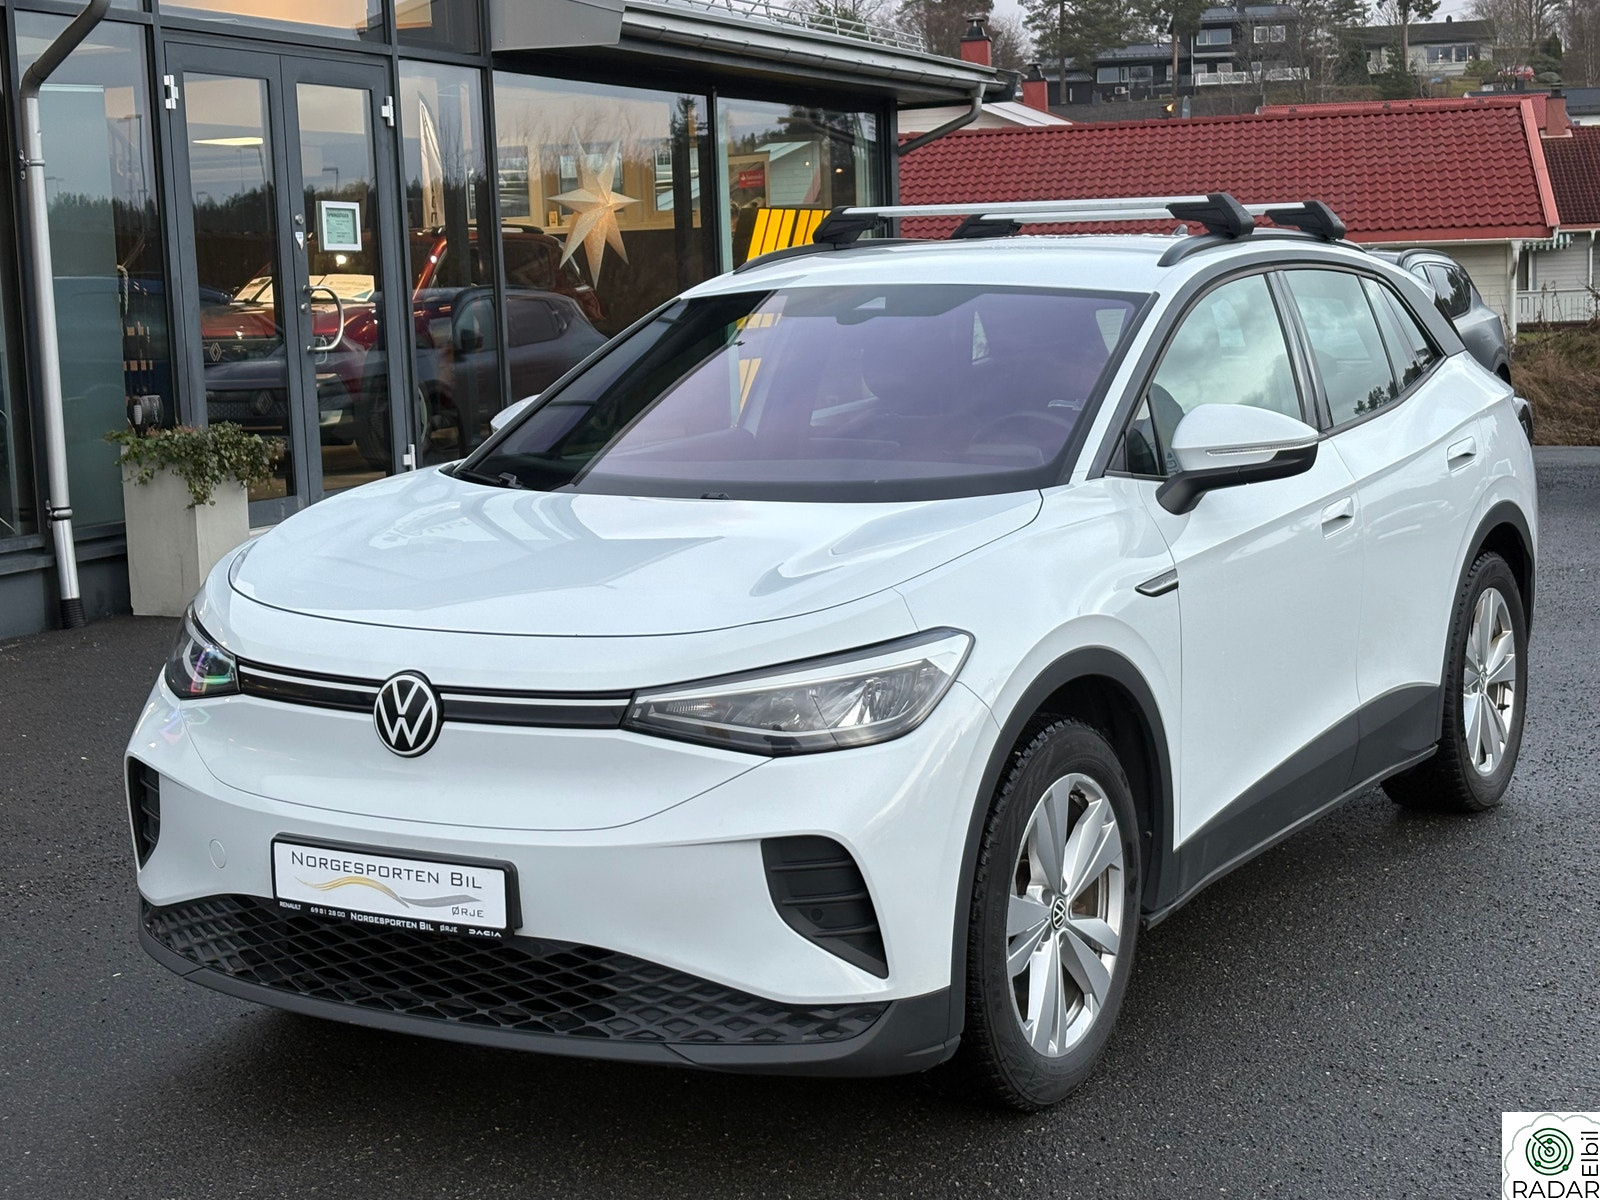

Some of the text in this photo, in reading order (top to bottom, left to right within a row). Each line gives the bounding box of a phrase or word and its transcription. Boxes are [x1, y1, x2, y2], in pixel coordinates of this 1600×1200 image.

[377, 678, 434, 749] VW
[279, 900, 302, 911] RENAULT
[451, 906, 484, 919] ØRJE
[468, 928, 502, 938] DACIA
